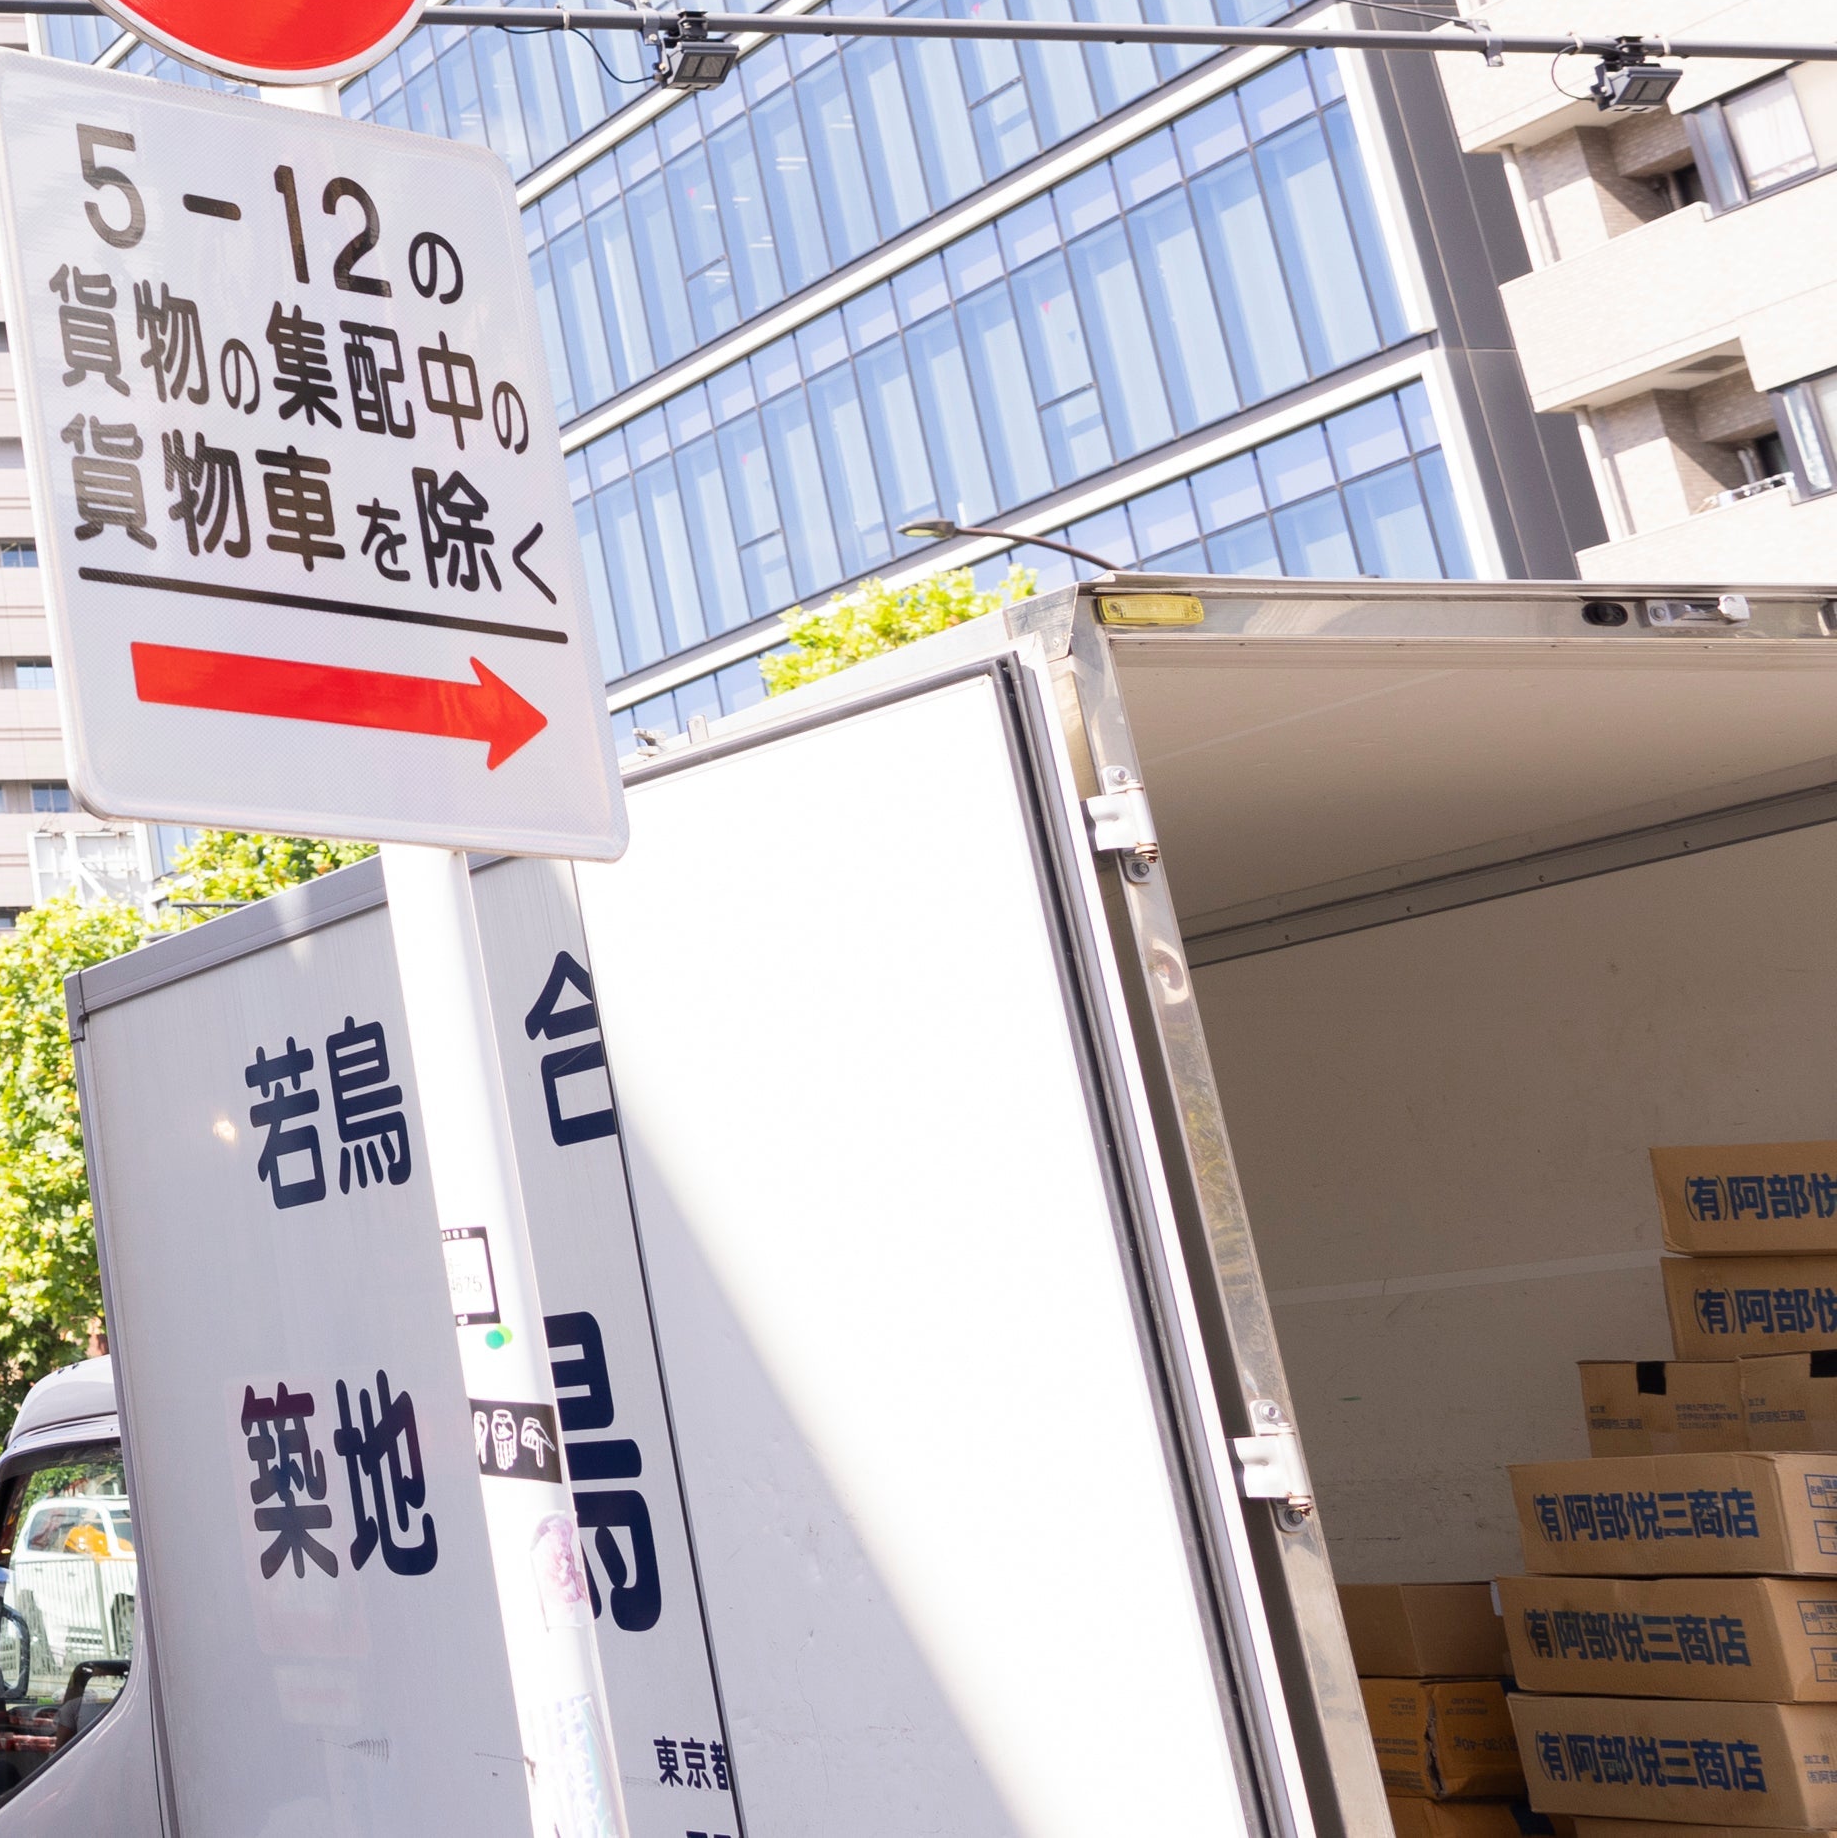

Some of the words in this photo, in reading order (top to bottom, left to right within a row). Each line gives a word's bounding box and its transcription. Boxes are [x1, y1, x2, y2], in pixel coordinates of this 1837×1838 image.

[48, 262, 530, 456] 貨物の集配中の
[60, 412, 559, 606] 貨物車を除く
[244, 1015, 412, 1210] 若鳥
[240, 1368, 439, 1582] 築地
[1532, 1487, 1761, 1544] (有)阿部悦三商店
[1525, 1608, 1753, 1667] (有)阿部悦三商店
[1535, 1730, 1769, 1794] (有)阿部悦三商店
